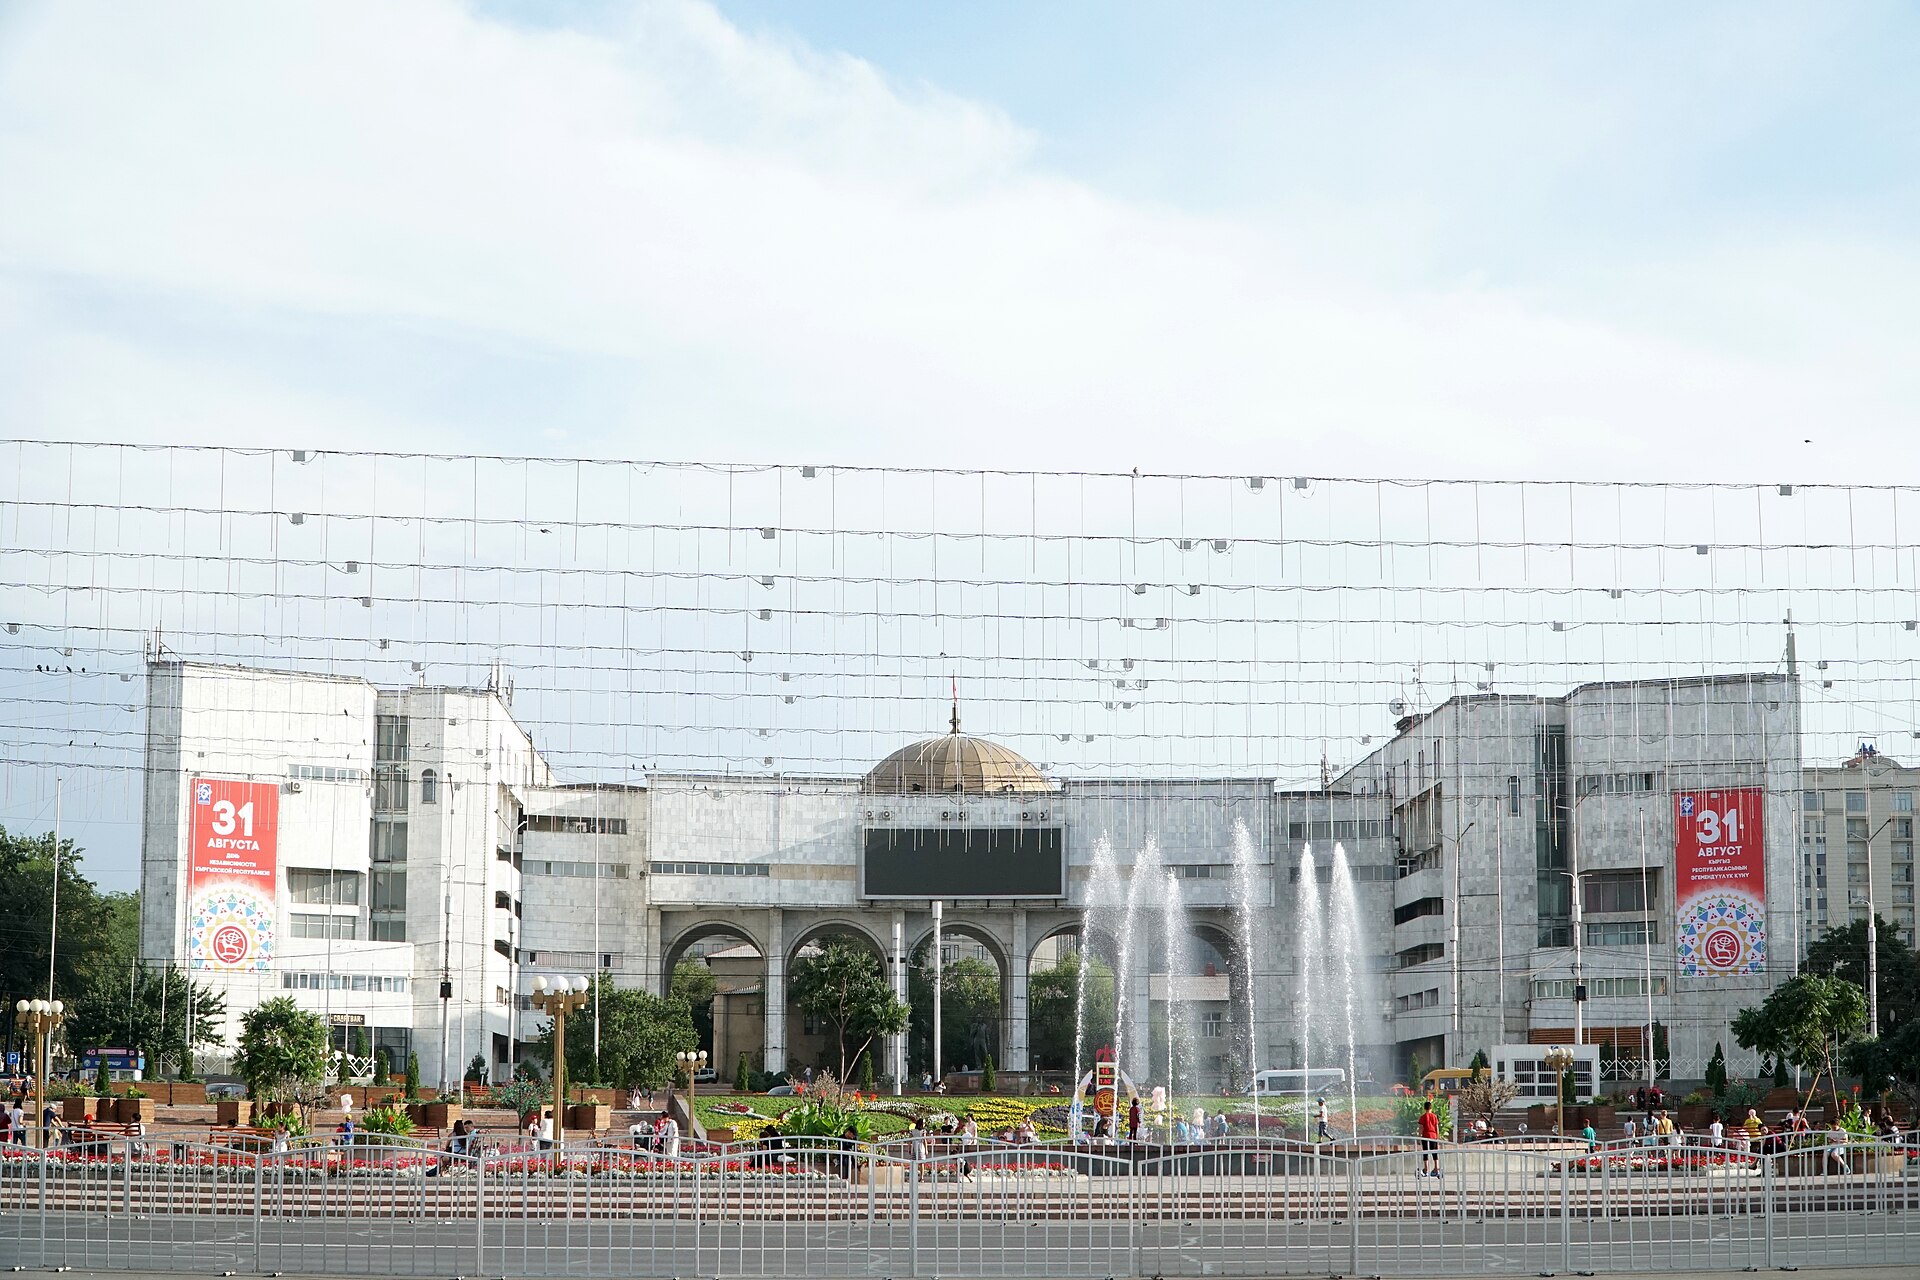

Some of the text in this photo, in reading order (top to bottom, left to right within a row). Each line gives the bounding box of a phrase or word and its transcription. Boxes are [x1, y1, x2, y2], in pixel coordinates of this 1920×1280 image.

[211, 799, 254, 837] 31
[1695, 808, 1738, 844] 31
[207, 837, 260, 851] АВГУСТА
[1697, 845, 1743, 858] АВГУСТ
[10, 1053, 17, 1063] P
